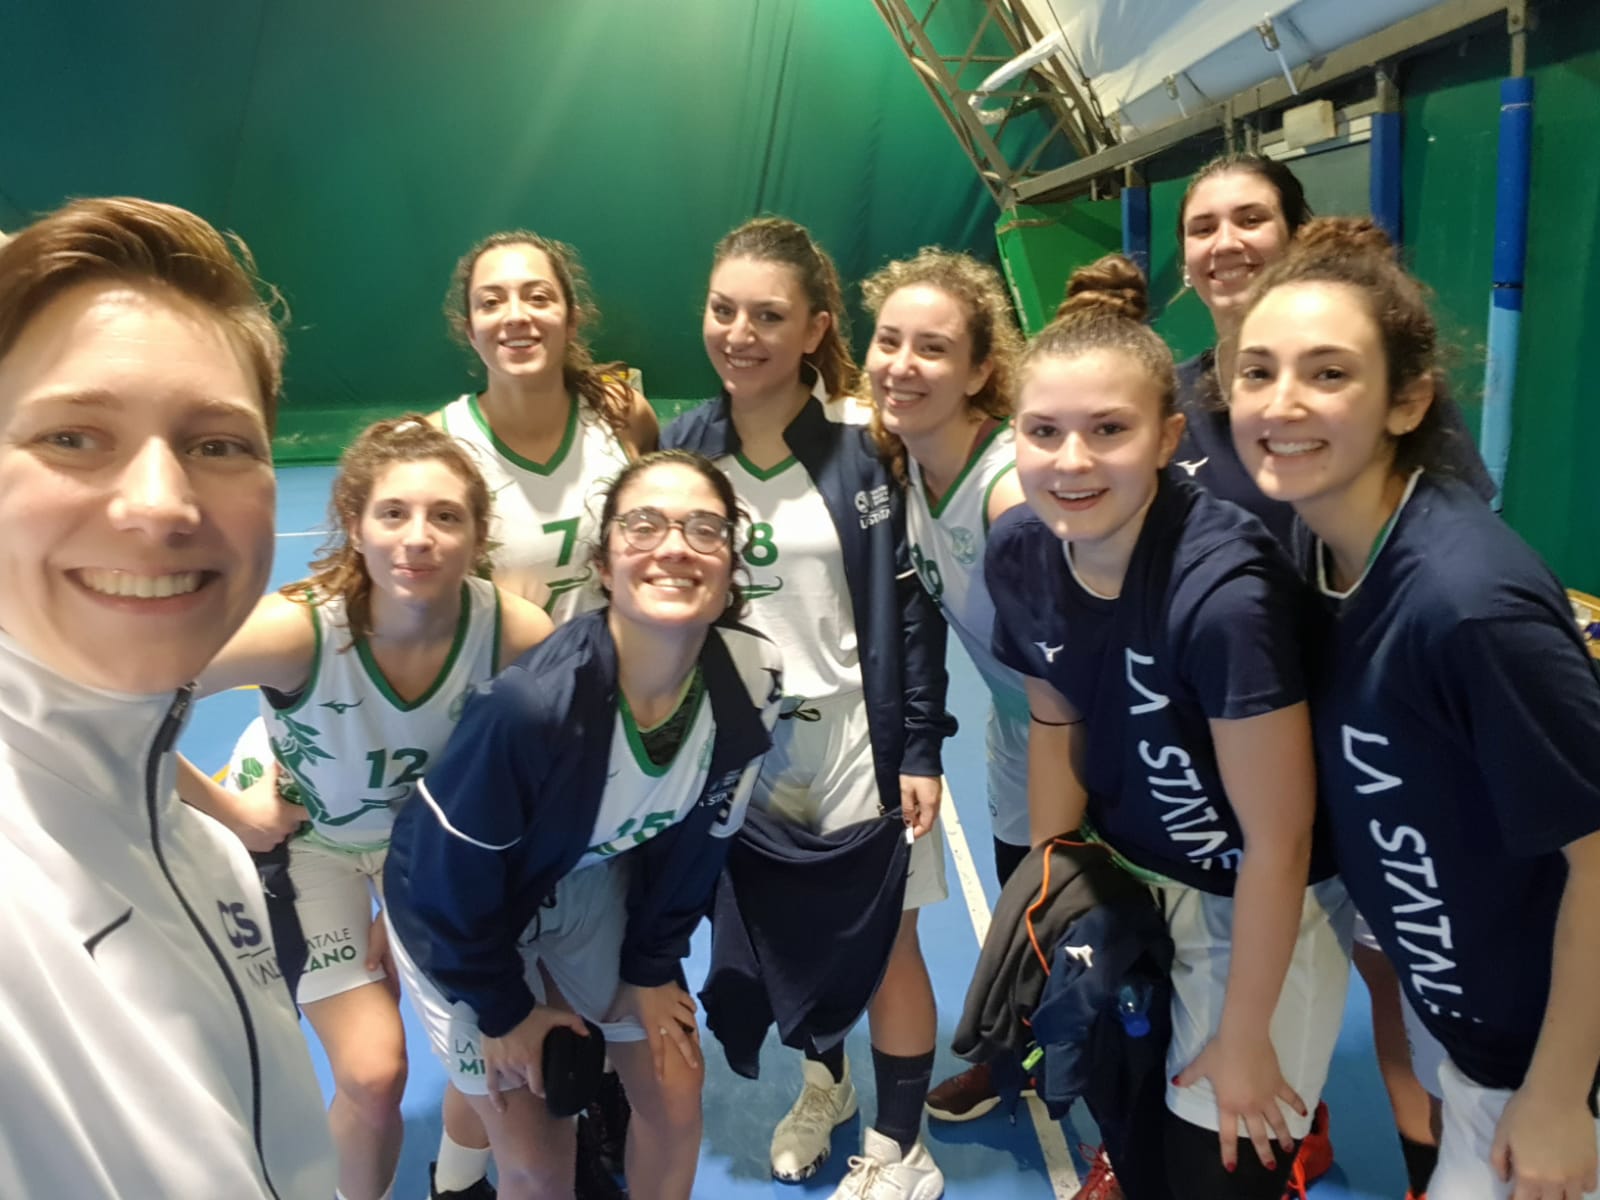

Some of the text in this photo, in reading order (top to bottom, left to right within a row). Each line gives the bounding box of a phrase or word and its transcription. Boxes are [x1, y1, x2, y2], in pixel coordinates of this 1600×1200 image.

[542, 516, 581, 568] 7
[742, 522, 778, 567] 8
[1125, 647, 1170, 715] LA
[365, 747, 429, 789] 12
[1341, 723, 1403, 795] LA
